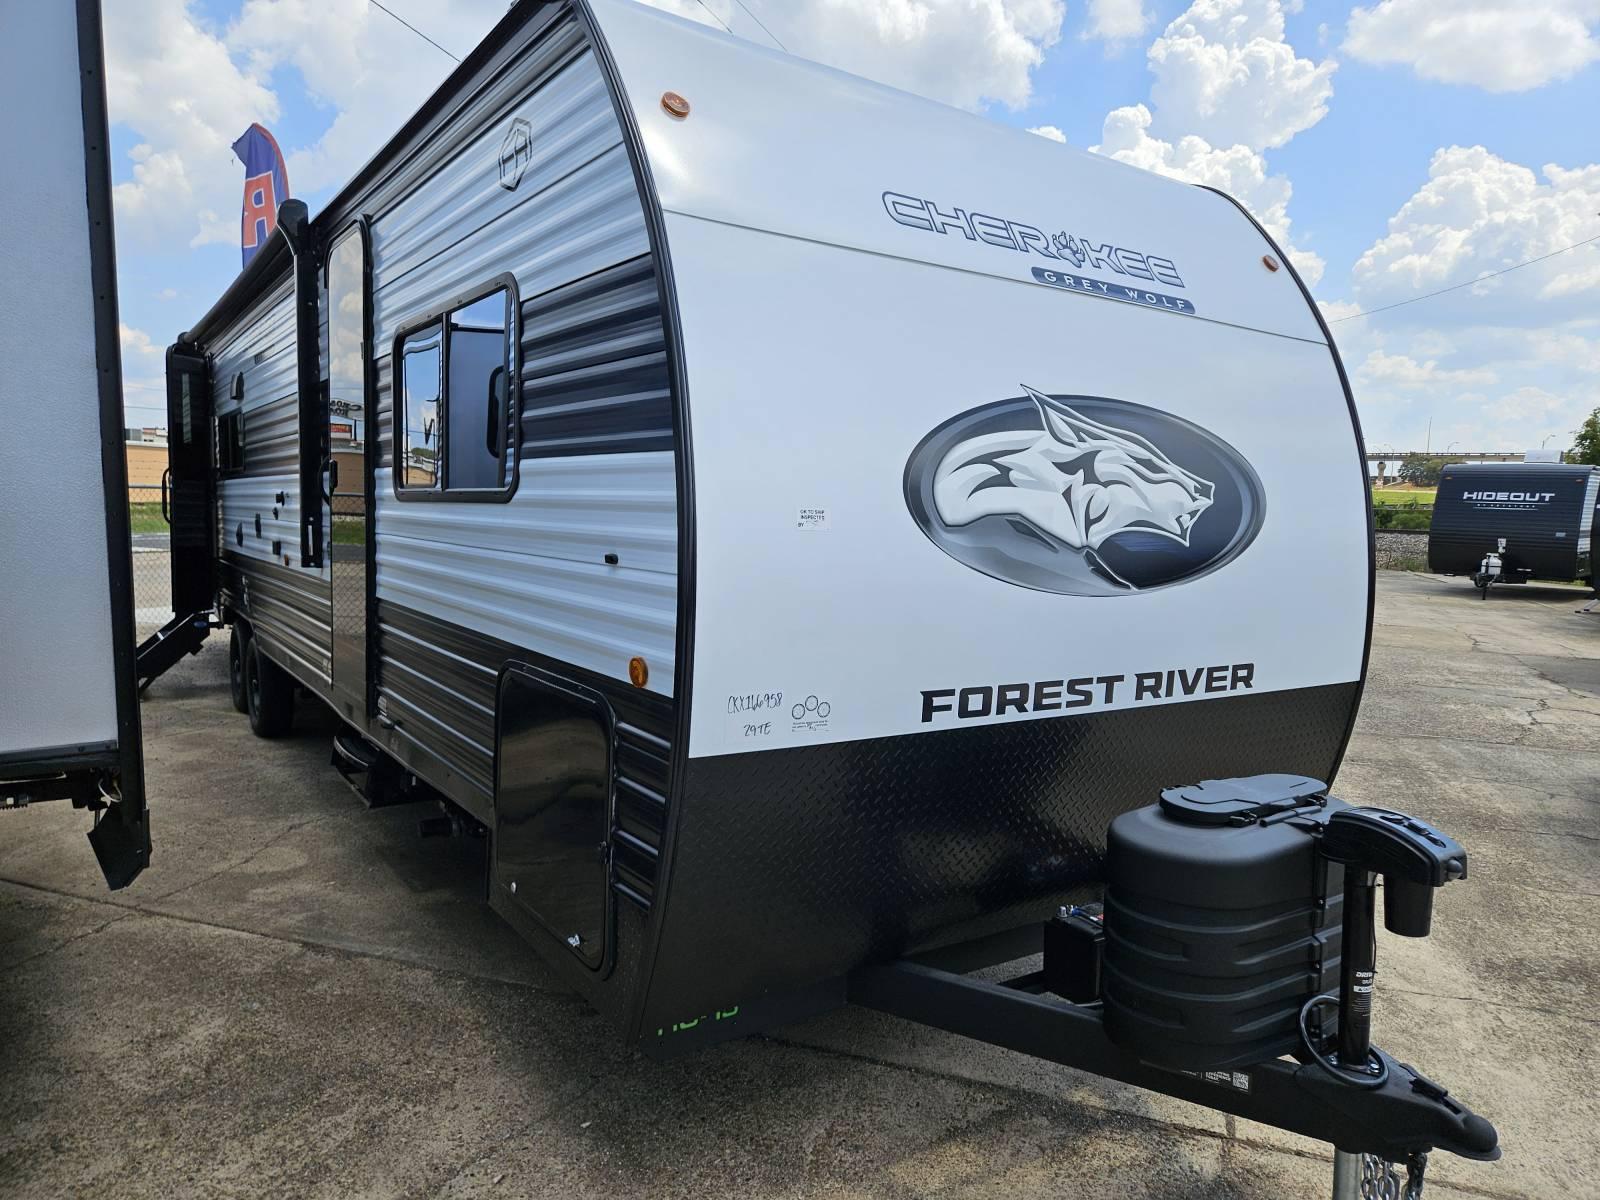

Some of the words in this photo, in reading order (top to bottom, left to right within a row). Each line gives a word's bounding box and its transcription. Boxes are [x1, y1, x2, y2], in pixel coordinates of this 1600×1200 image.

[1044, 271, 1111, 294] GREY
[1125, 288, 1186, 310] WOLF
[1463, 491, 1555, 502] HIDEOUT
[920, 674, 1125, 723] FOREST
[1134, 662, 1255, 701] RIVER
